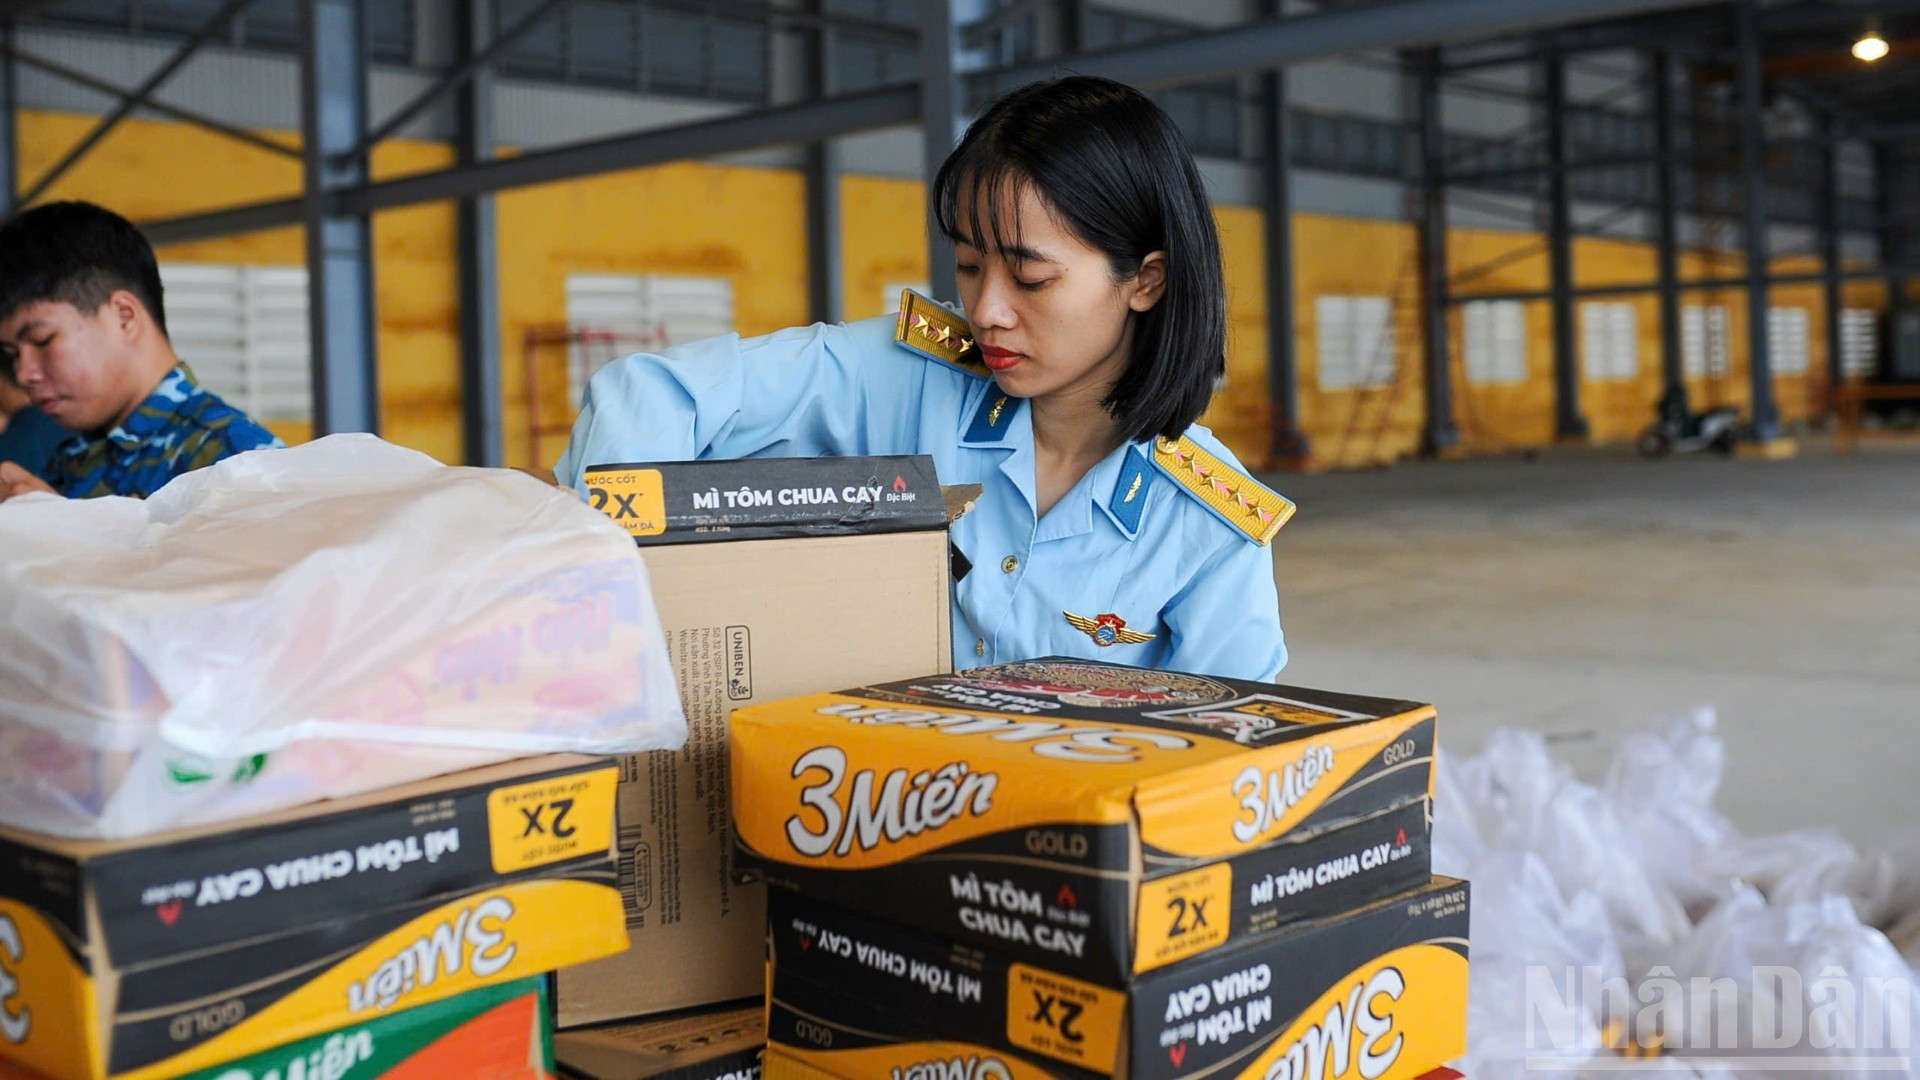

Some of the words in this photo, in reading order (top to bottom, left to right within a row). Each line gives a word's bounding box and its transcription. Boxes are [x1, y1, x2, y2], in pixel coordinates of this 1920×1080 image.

[693, 487, 720, 510] MÌ
[724, 485, 773, 508] TÔM
[778, 488, 839, 506] CHUA
[842, 485, 884, 504] CAY
[732, 631, 744, 677] UNIBEN
[1383, 739, 1416, 766] GOLD
[355, 835, 423, 873] TÔM
[424, 827, 460, 863] MÌ
[1025, 829, 1089, 859] GOLD
[195, 867, 264, 907] CAY
[264, 849, 354, 891] CHUA
[1250, 873, 1274, 907] MÌ
[1275, 866, 1314, 898] TÔM
[1315, 853, 1360, 886] CHUA
[1361, 842, 1391, 870] CAY
[950, 871, 982, 904] MÌ
[983, 878, 1044, 917] TÔM
[817, 929, 853, 958] CAY
[958, 906, 1031, 944] CHUA
[1034, 923, 1086, 959] CAY
[855, 940, 907, 977] CHUA
[910, 959, 954, 994] TÔM
[957, 974, 982, 1004] MÌ
[1164, 983, 1211, 1023] CAY
[1211, 962, 1272, 1005] CHUA
[168, 999, 246, 1042] GOLD
[796, 1019, 833, 1048] GOLD
[1197, 1005, 1246, 1047] TÔM
[1245, 994, 1272, 1034] MÌ
